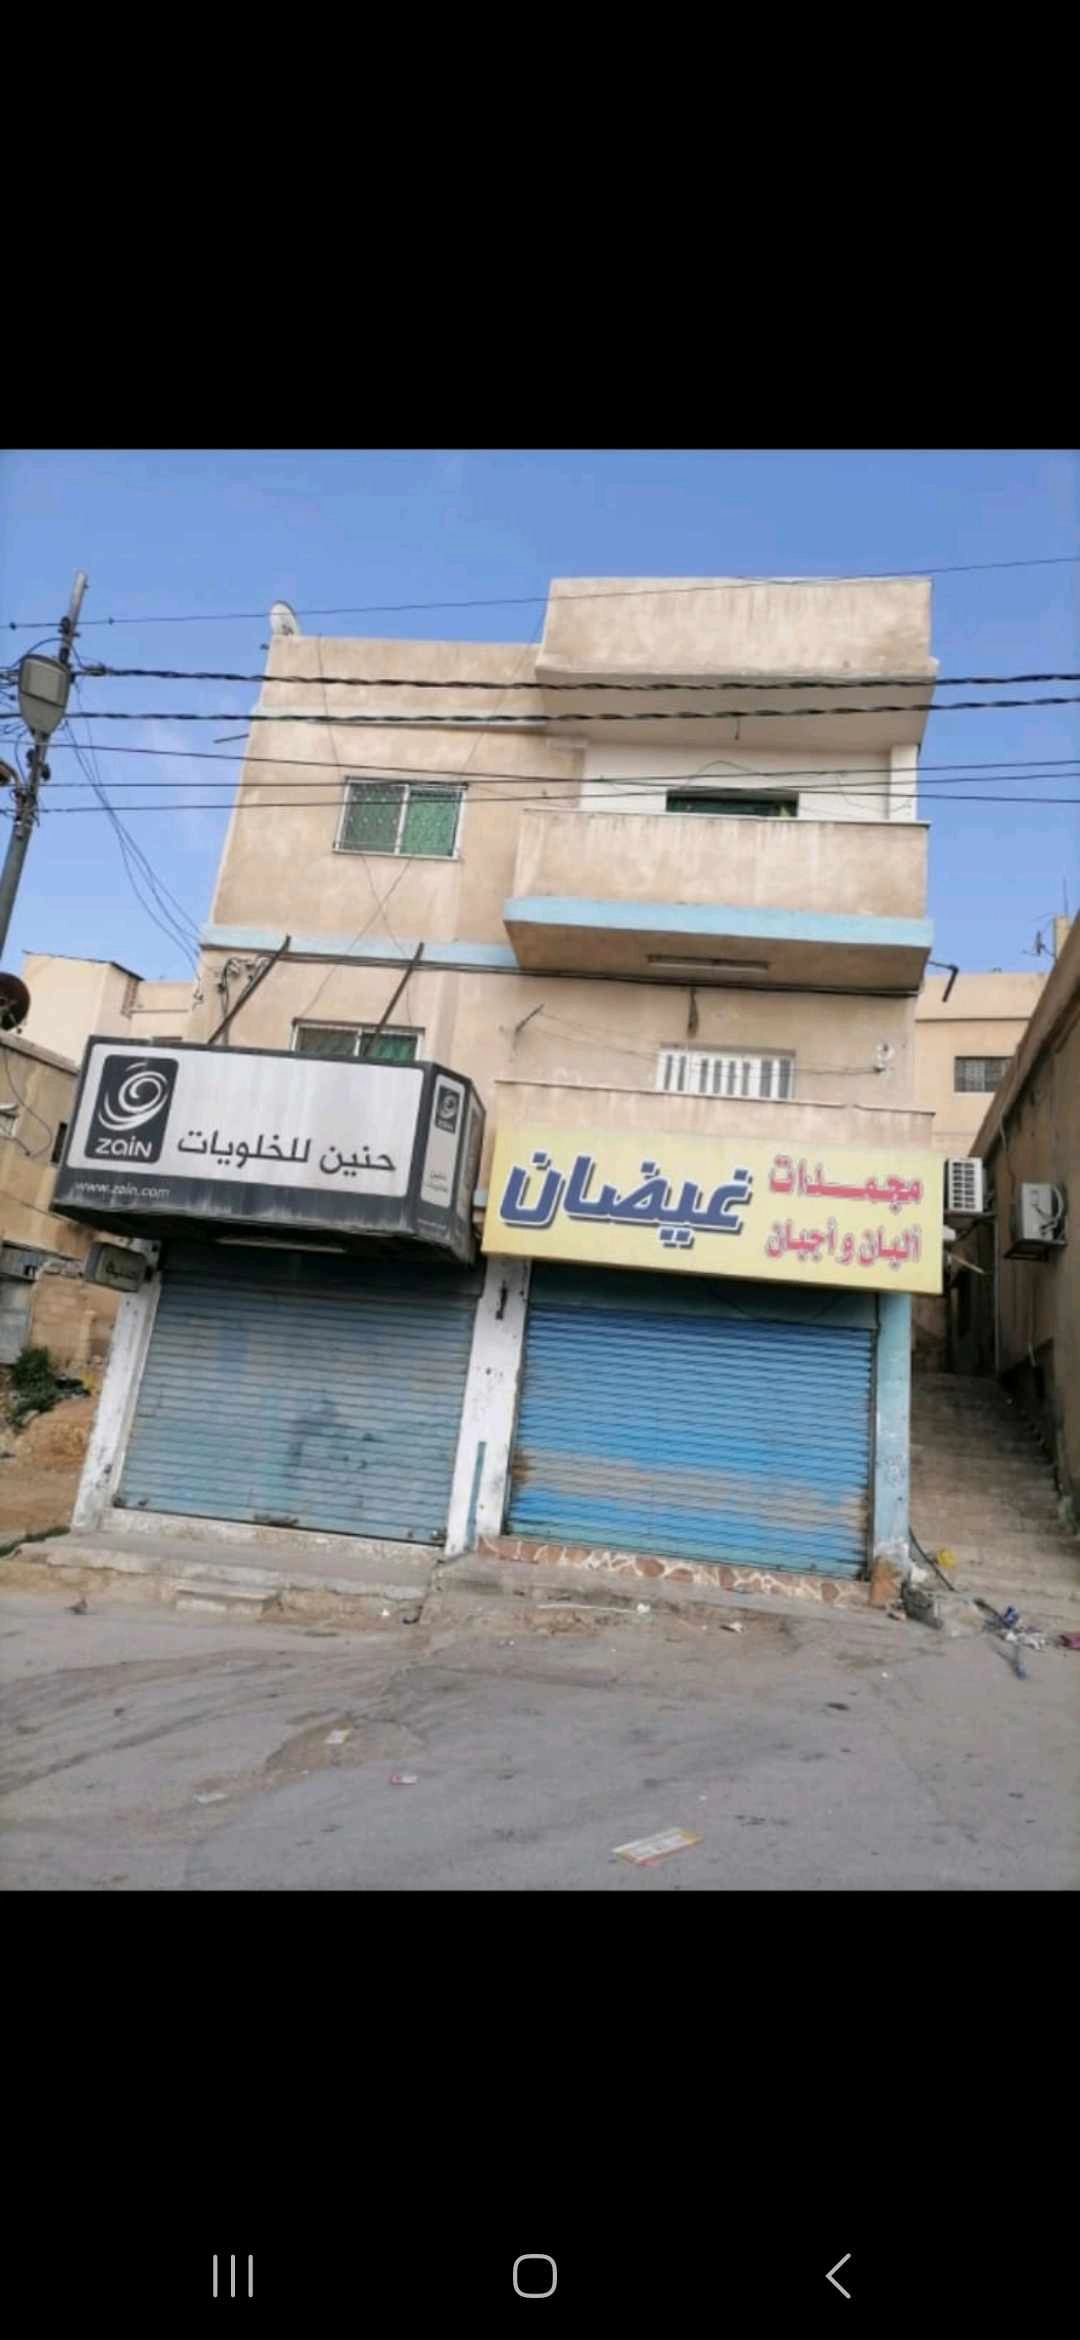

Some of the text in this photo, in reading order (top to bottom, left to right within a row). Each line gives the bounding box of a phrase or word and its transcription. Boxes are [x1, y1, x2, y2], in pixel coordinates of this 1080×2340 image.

[177, 1129, 397, 1177] حنين للخلويات
[75, 1181, 170, 1199] www.zain.com
[500, 1150, 754, 1249] غيضان
[768, 1154, 924, 1214] مجمدات
